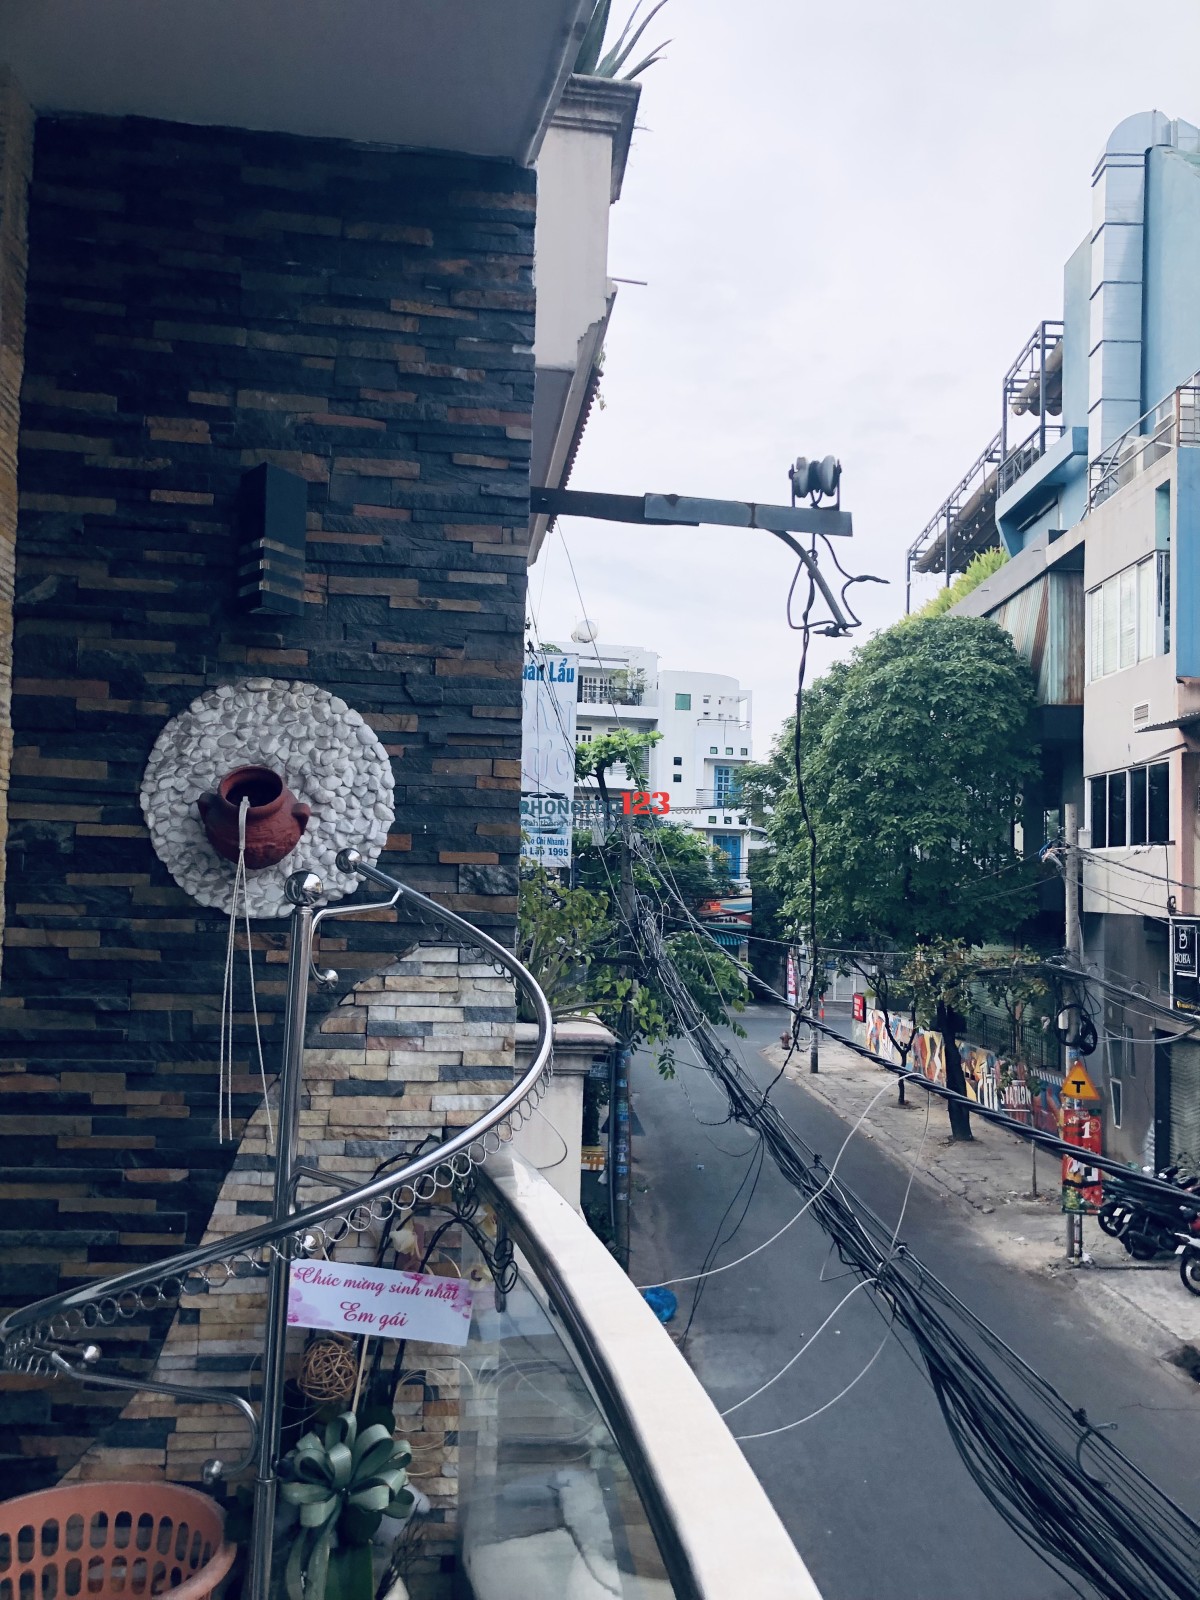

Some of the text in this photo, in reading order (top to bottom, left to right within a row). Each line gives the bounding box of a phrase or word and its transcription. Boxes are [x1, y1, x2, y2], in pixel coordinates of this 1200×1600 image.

[549, 658, 575, 683] Lẩu
[548, 847, 569, 857] 1995
[1174, 952, 1191, 964] BOBA
[297, 1266, 341, 1287] Chúc
[343, 1275, 386, 1297] mừng
[389, 1281, 422, 1296] sinh
[340, 1301, 409, 1331] Em gái
